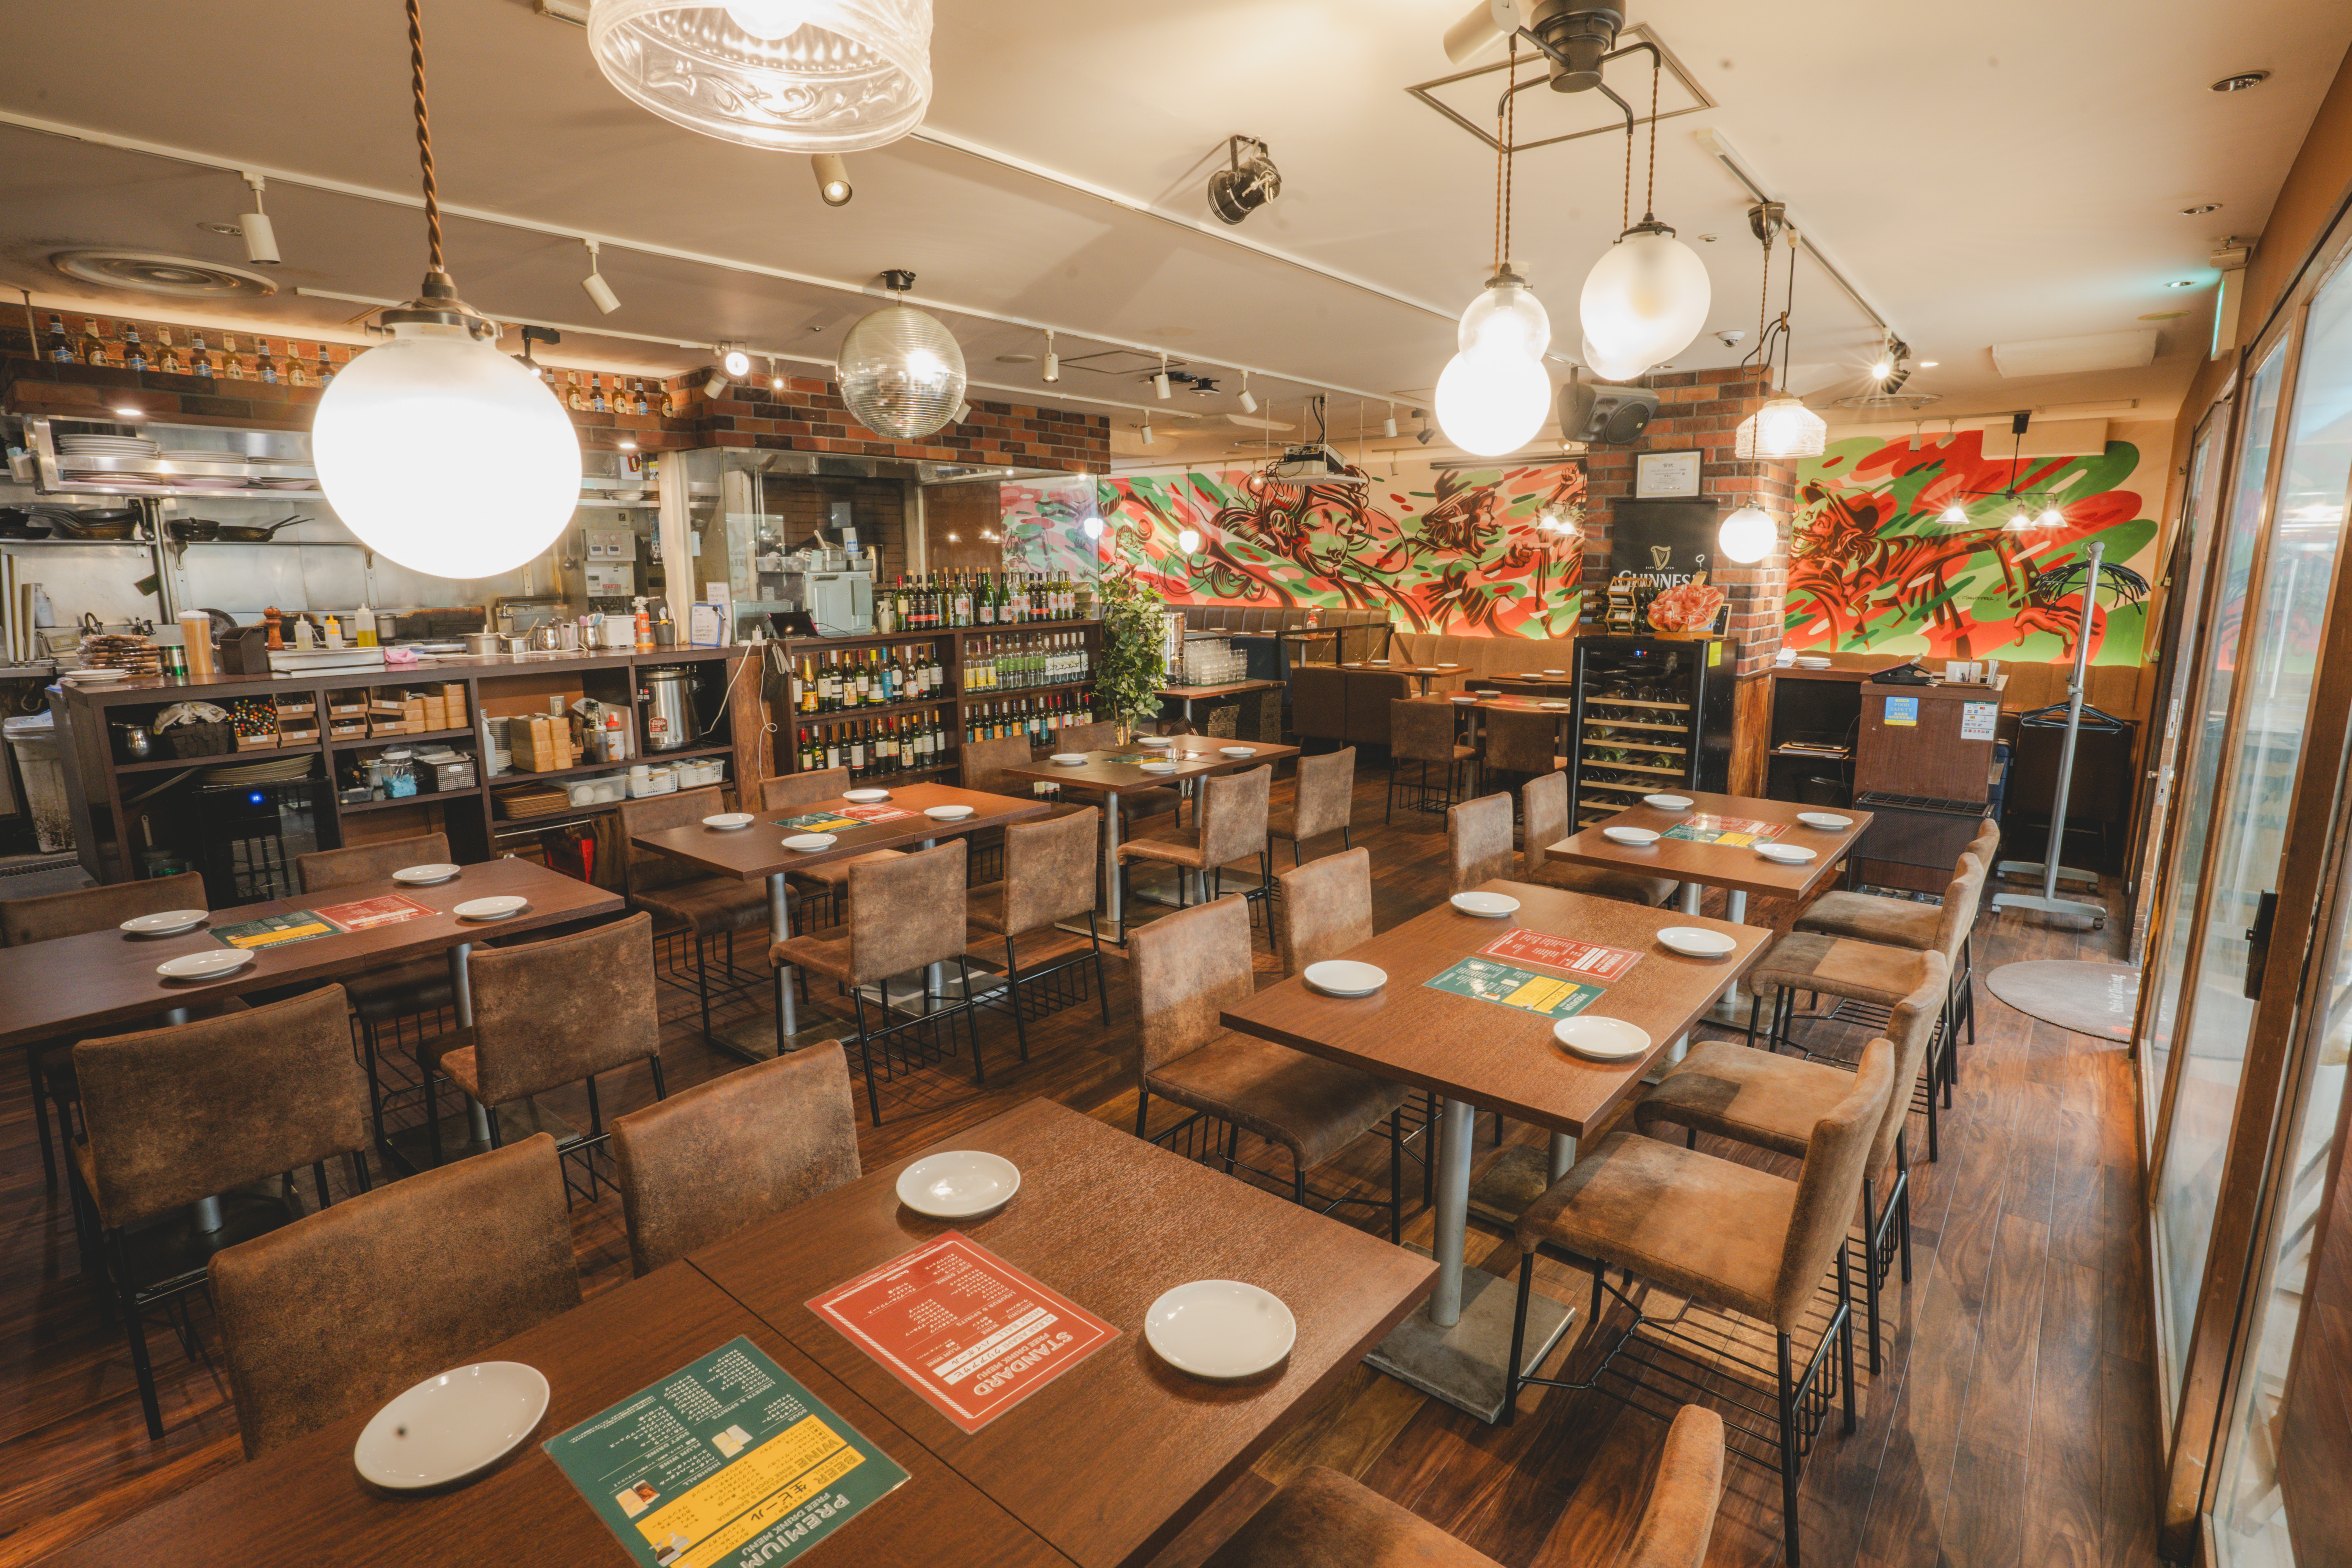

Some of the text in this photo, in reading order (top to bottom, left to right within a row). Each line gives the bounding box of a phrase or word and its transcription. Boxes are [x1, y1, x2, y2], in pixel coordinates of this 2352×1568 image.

[1597, 953, 1624, 972] STANDARD
[1561, 993, 1589, 1011] PREMIUM
[935, 1264, 972, 1285] SOFT DRINK
[987, 1291, 1016, 1308] LIQUEUR
[1007, 1303, 1034, 1319] SHOCHU
[956, 1311, 982, 1326] SPIRITS
[981, 1323, 999, 1335] WINE
[995, 1309, 1042, 1337] HIGH BALL
[1002, 1316, 1053, 1348] CLEAR ASAHI
[926, 1356, 944, 1367] WINE
[942, 1345, 961, 1357] PLUM
[951, 1340, 989, 1364] ハイボール
[954, 1348, 1000, 1377] クリアアサヒ
[976, 1332, 1050, 1380] FREE DRINK MENU
[973, 1332, 1073, 1396] STANDARD
[711, 1402, 739, 1419] SPIRITS
[788, 1408, 807, 1421] SOUR
[644, 1431, 690, 1459] SOFT DRINK
[659, 1442, 701, 1469] PLUM WINE
[794, 1439, 840, 1468] WINE
[682, 1461, 721, 1485] HIGHBALL
[758, 1468, 797, 1494] SPARKLING
[813, 1454, 858, 1484] BEER
[738, 1465, 793, 1500] WINE COCKTAIL
[716, 1499, 750, 1521] SANGRIA
[751, 1481, 806, 1521] 生ビール
[739, 1494, 850, 1568] PREMIUM
[742, 1492, 831, 1555] FREE DRINK MENU
